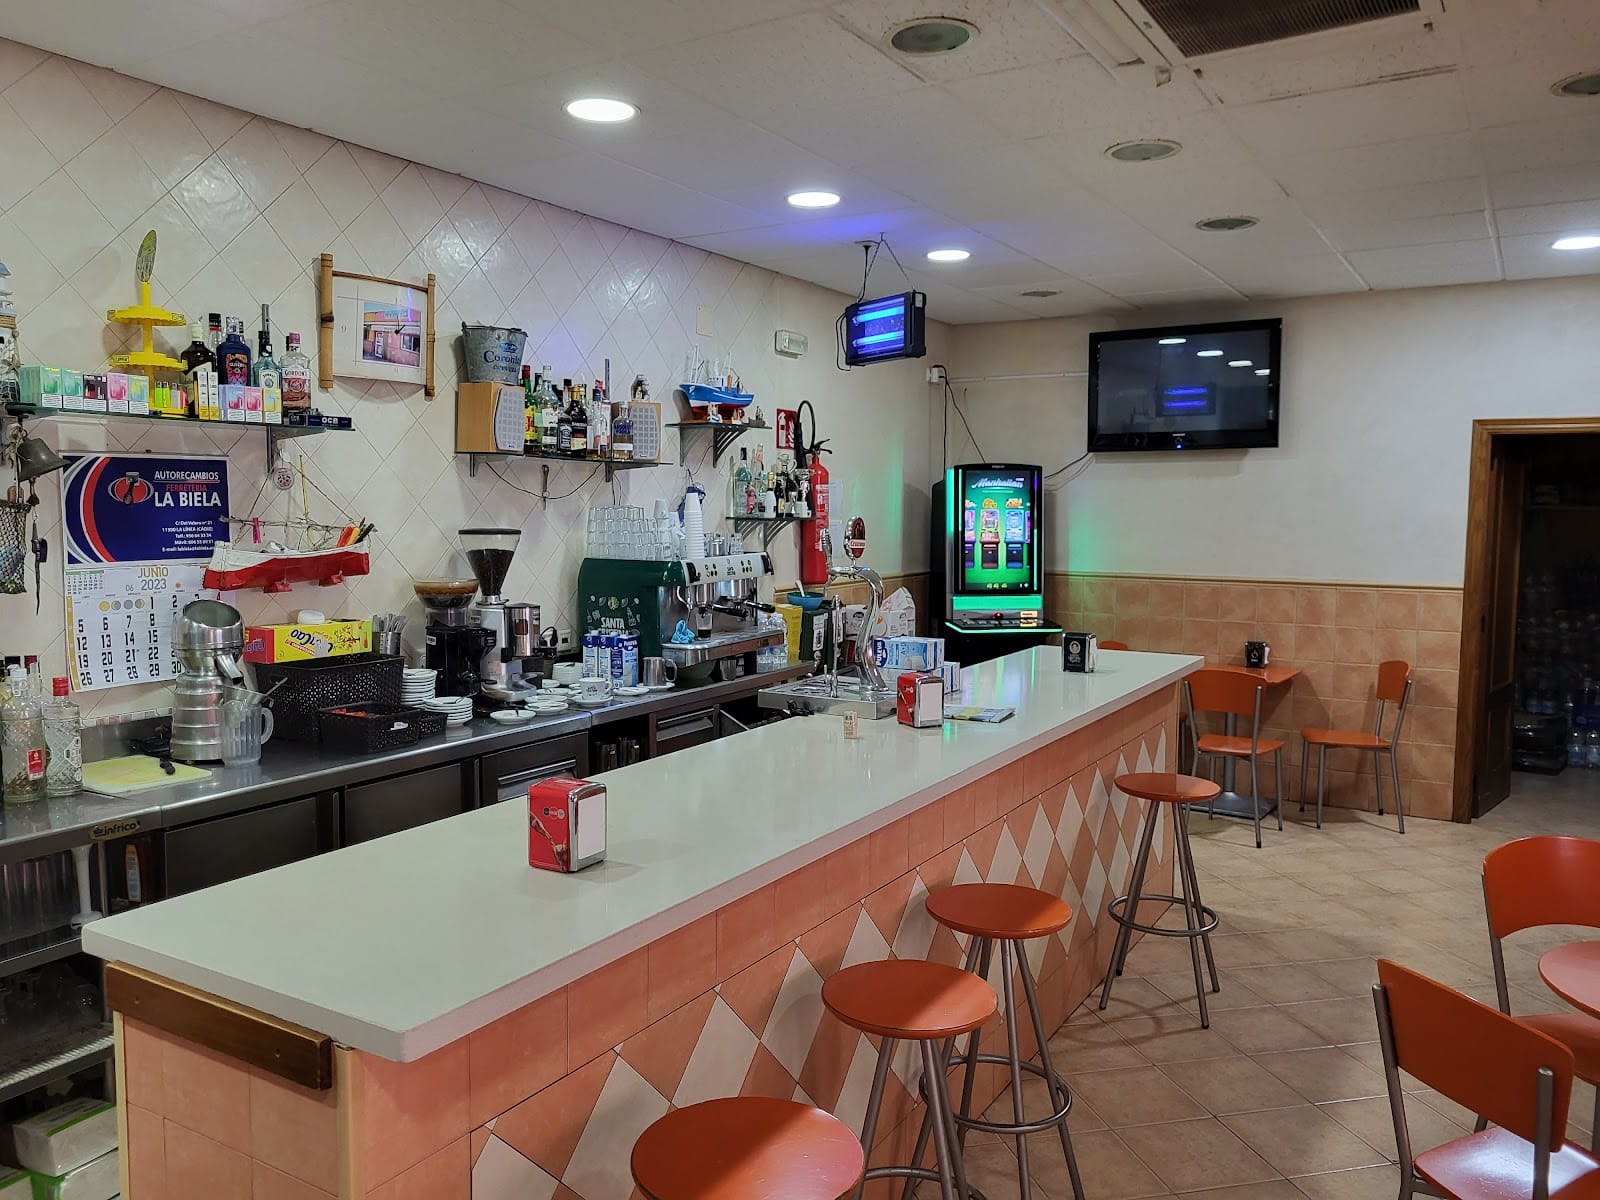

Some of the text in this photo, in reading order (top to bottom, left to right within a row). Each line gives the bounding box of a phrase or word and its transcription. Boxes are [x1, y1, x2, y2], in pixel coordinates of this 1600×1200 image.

[154, 471, 219, 480] AUTORECAMBIOS
[154, 491, 222, 507] LA BIELA
[138, 567, 169, 578] JUNIO
[141, 579, 167, 592] 2023
[150, 596, 154, 610] 1
[172, 595, 178, 608] 2
[78, 613, 155, 632] 5 6 7 8
[600, 617, 625, 630] SANTA
[77, 630, 158, 651] 12 13 14 15
[78, 654, 88, 668] 19
[102, 652, 112, 666] 20
[125, 649, 136, 663] 21
[148, 647, 158, 660] 22
[80, 661, 182, 686] 26 27 28 29 30
[104, 822, 137, 836] infrico
